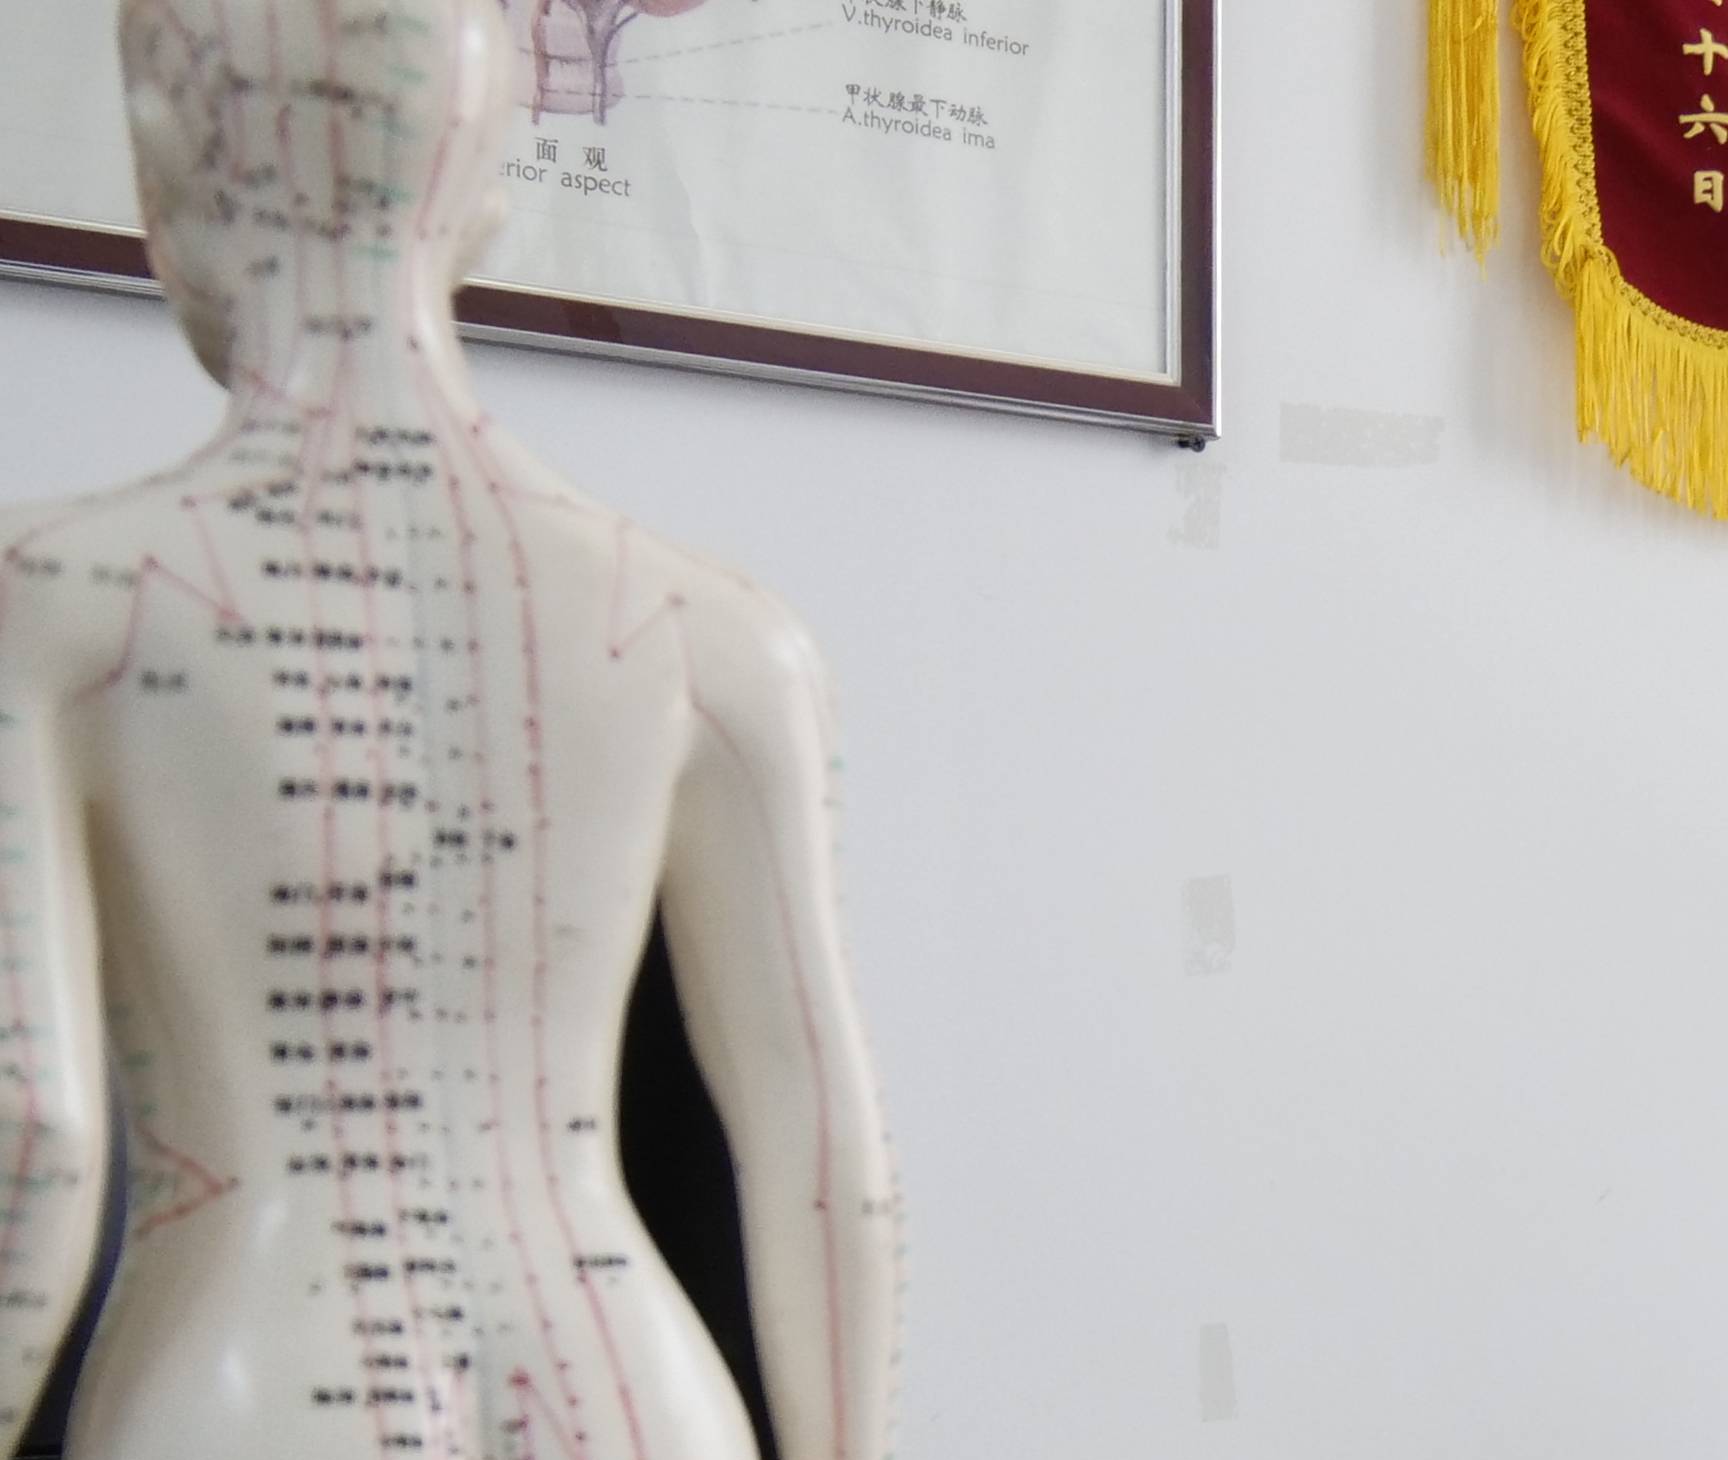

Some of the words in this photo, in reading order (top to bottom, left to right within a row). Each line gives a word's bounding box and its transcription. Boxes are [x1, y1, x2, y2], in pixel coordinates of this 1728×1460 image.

[842, 4, 953, 42] V.thyroidea
[963, 27, 1030, 56] inferior
[845, 84, 988, 127] 甲状腺最下动脉
[842, 107, 952, 142] A.thyroidea
[962, 127, 996, 150] ima
[560, 170, 632, 197] aspect
